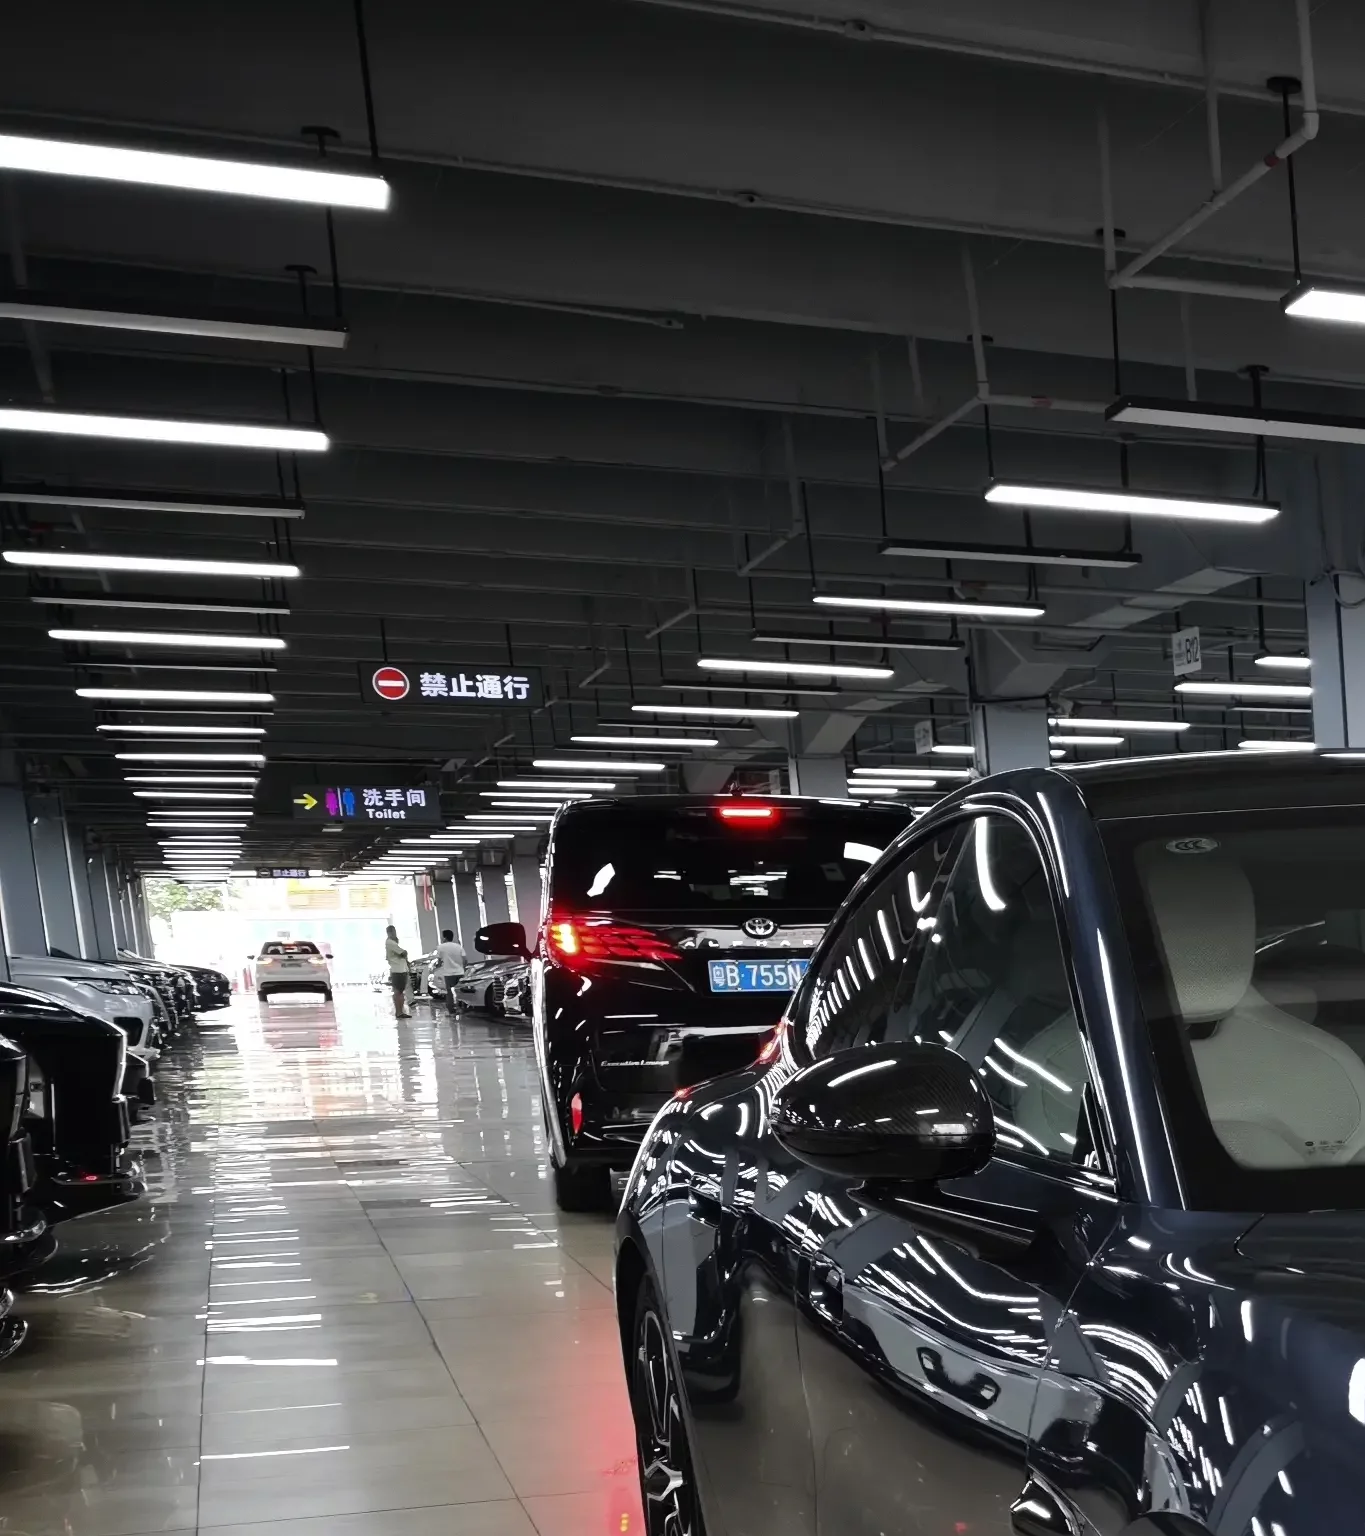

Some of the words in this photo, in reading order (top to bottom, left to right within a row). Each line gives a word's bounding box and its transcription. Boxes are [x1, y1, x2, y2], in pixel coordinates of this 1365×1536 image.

[419, 672, 530, 700] 禁止通行
[362, 788, 426, 807] 洗手间
[366, 808, 406, 819] Toilet
